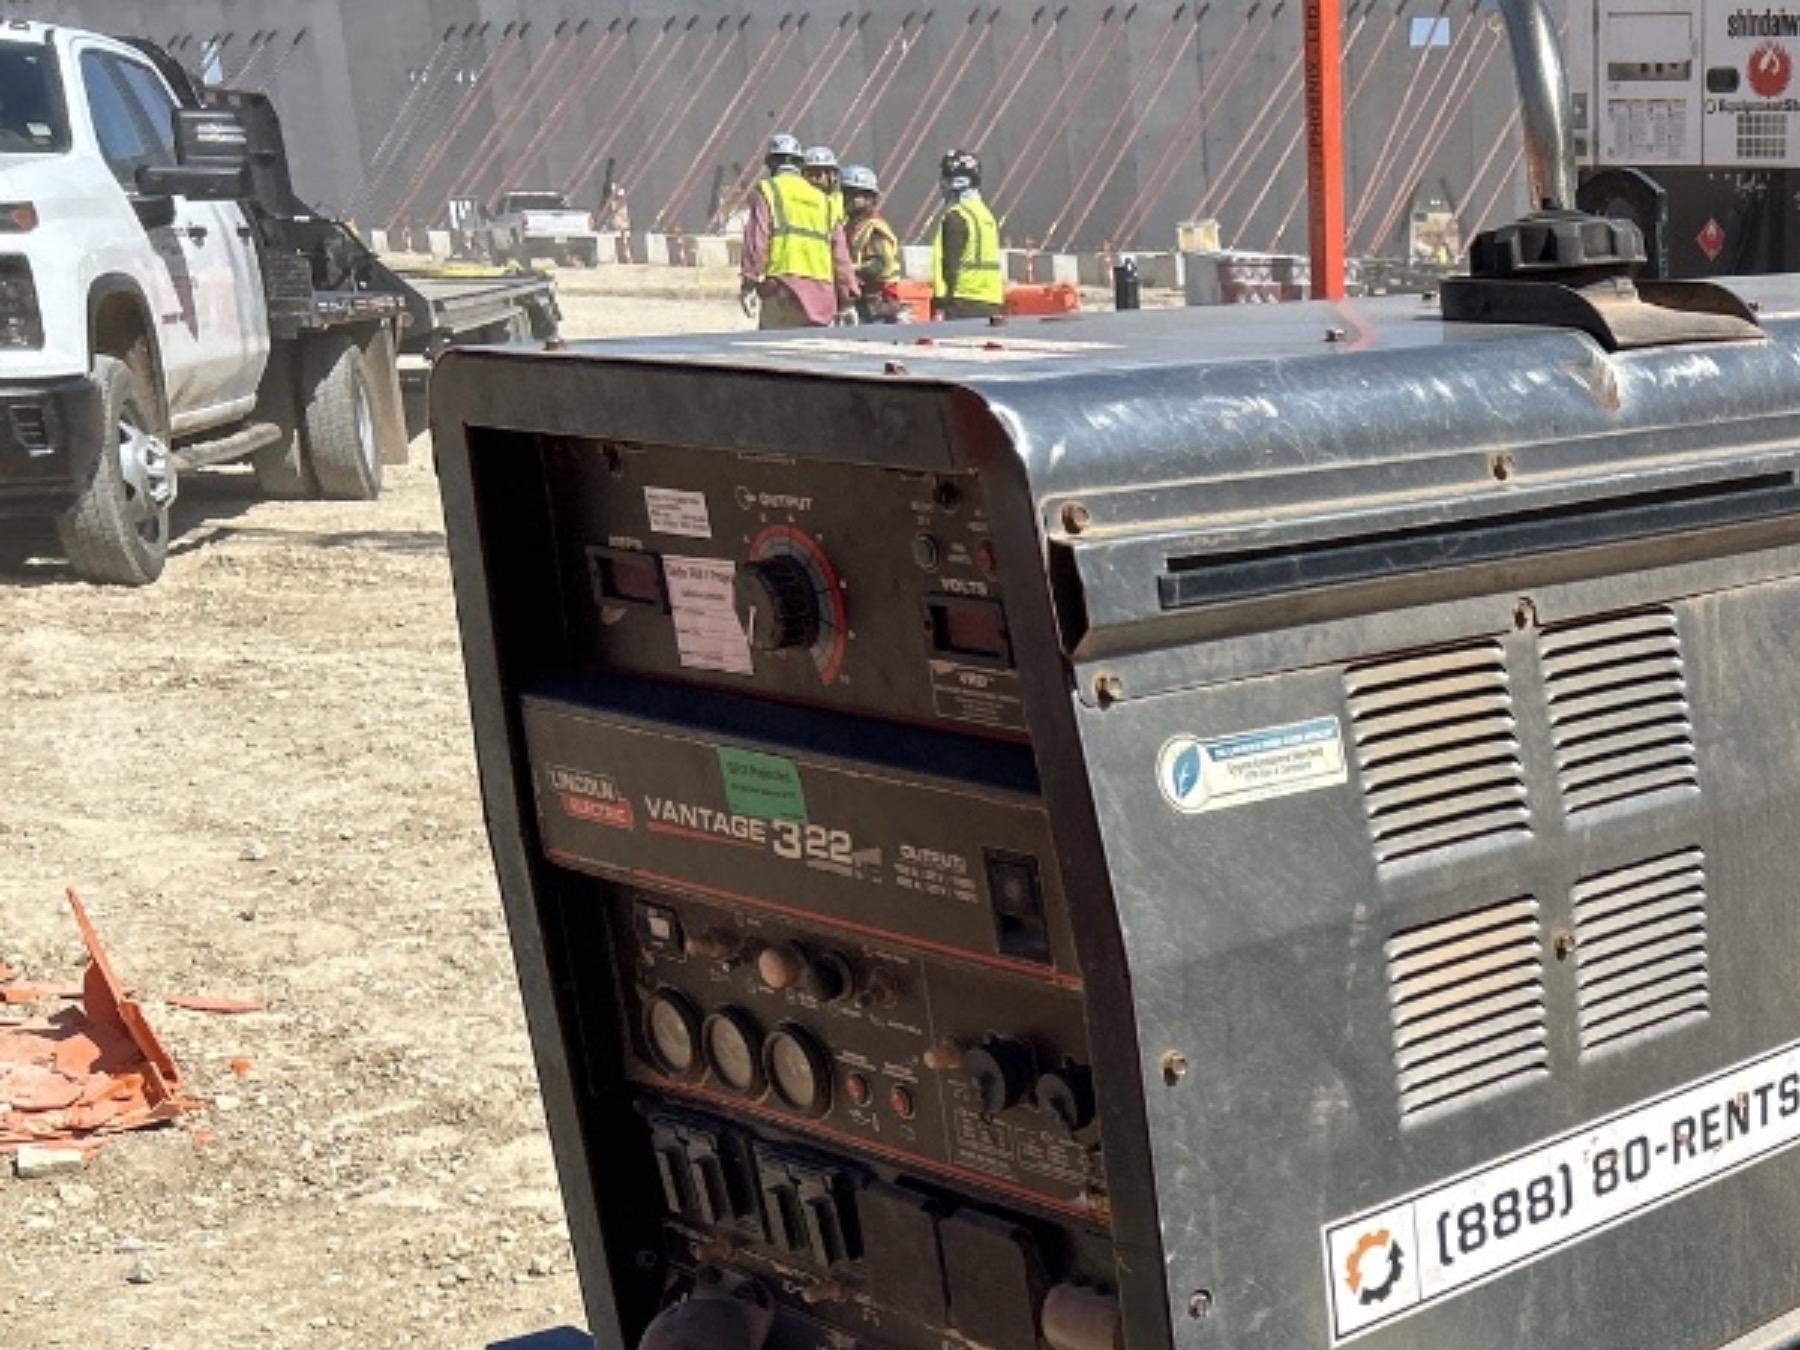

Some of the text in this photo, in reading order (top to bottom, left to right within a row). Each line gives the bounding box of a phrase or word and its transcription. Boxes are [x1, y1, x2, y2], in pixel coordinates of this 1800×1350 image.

[758, 491, 813, 512] OUTPUT
[940, 578, 987, 597] VOLTS
[645, 795, 855, 863] VANTAGE 322
[1436, 1072, 1800, 1266] (888) 80-RENTS
